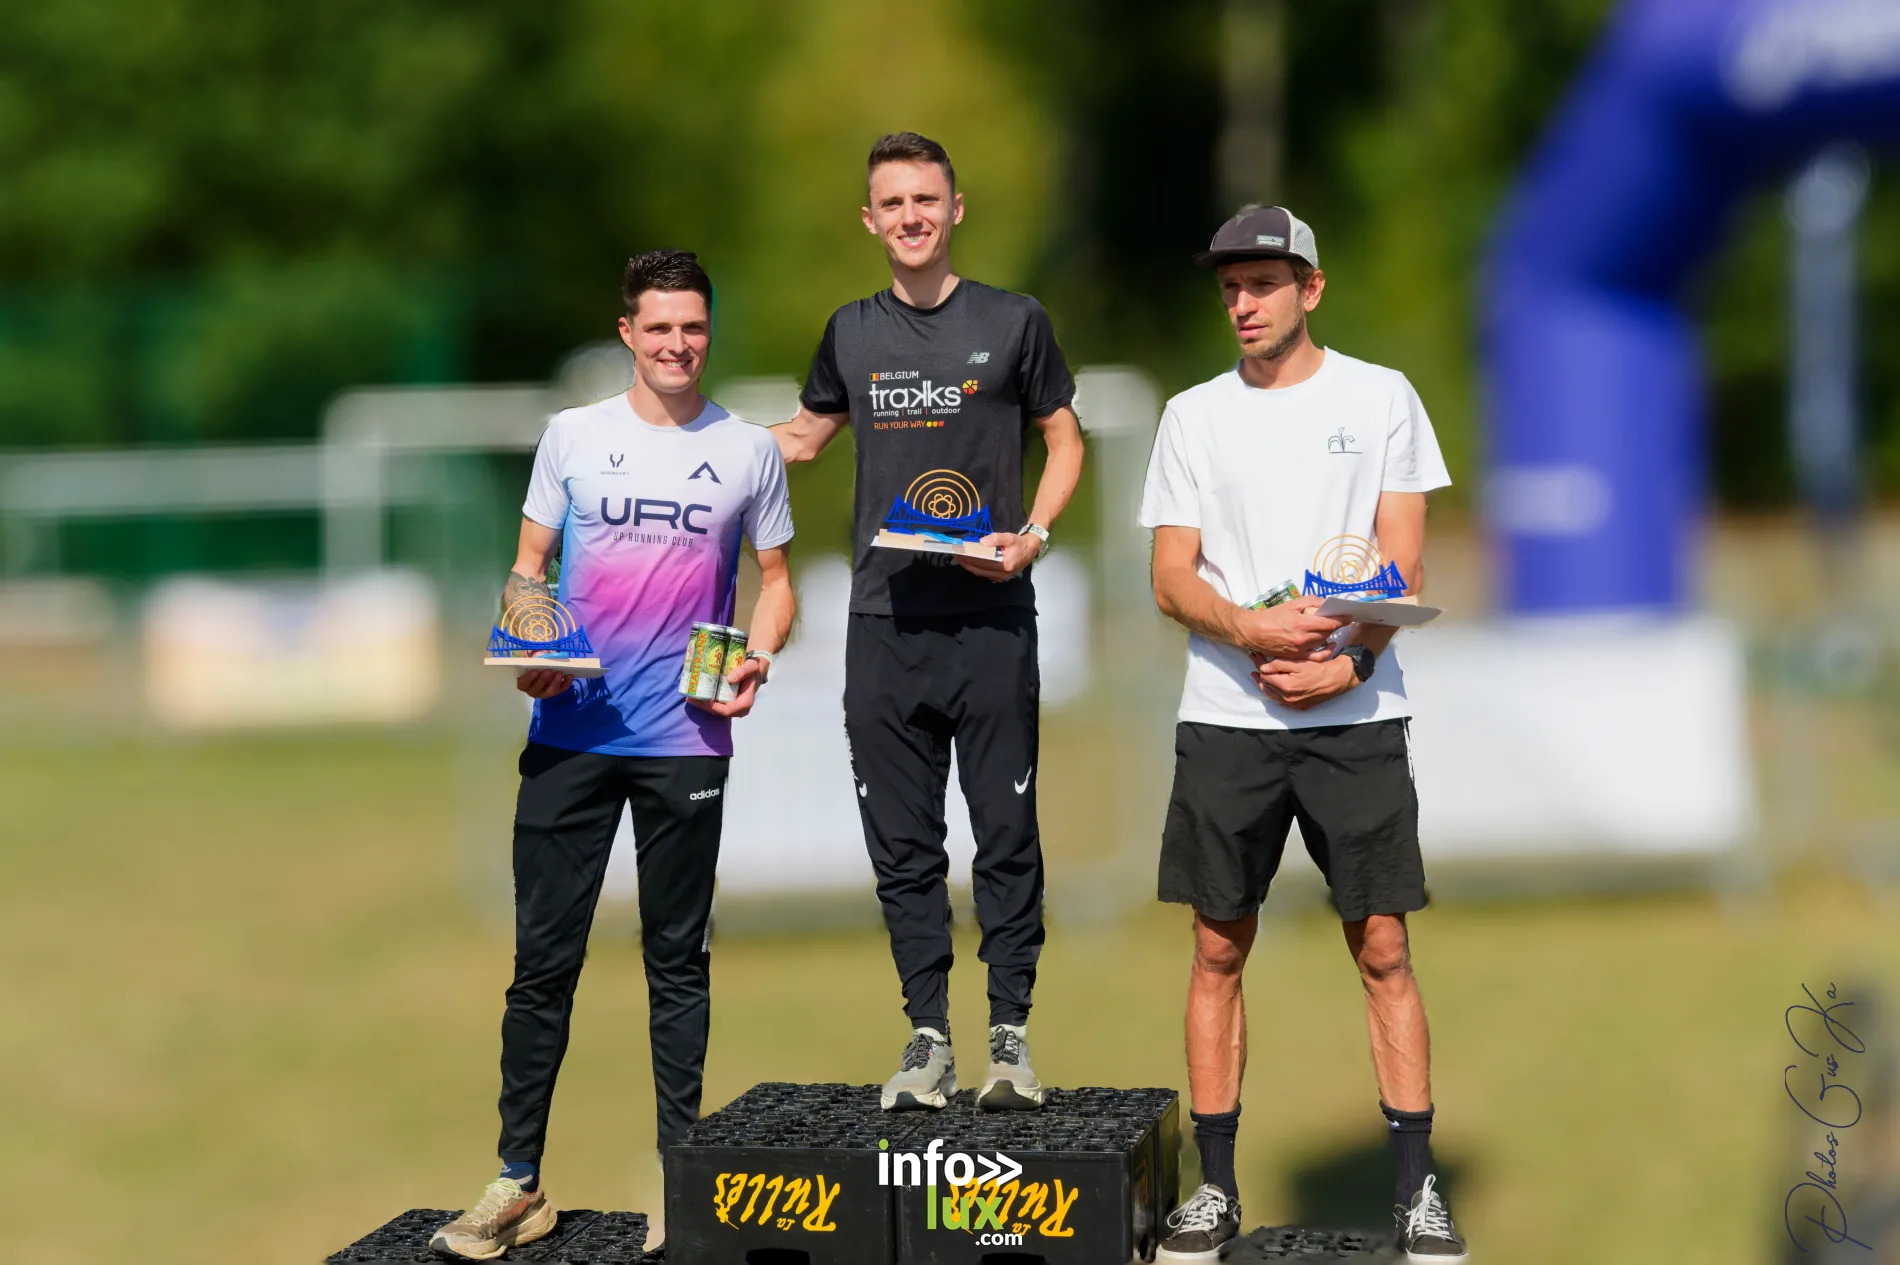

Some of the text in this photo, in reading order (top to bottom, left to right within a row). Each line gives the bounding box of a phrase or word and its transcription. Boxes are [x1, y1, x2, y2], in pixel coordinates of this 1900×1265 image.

[879, 370, 919, 380] BELGIUM
[869, 380, 962, 410] trakks
[873, 409, 899, 417] running
[874, 420, 926, 430] RUN YOUR WAY
[600, 496, 713, 535] URC
[613, 531, 694, 548] UP RUNNING CLUB
[688, 631, 708, 693] MAITRANK
[689, 788, 720, 801] adidas
